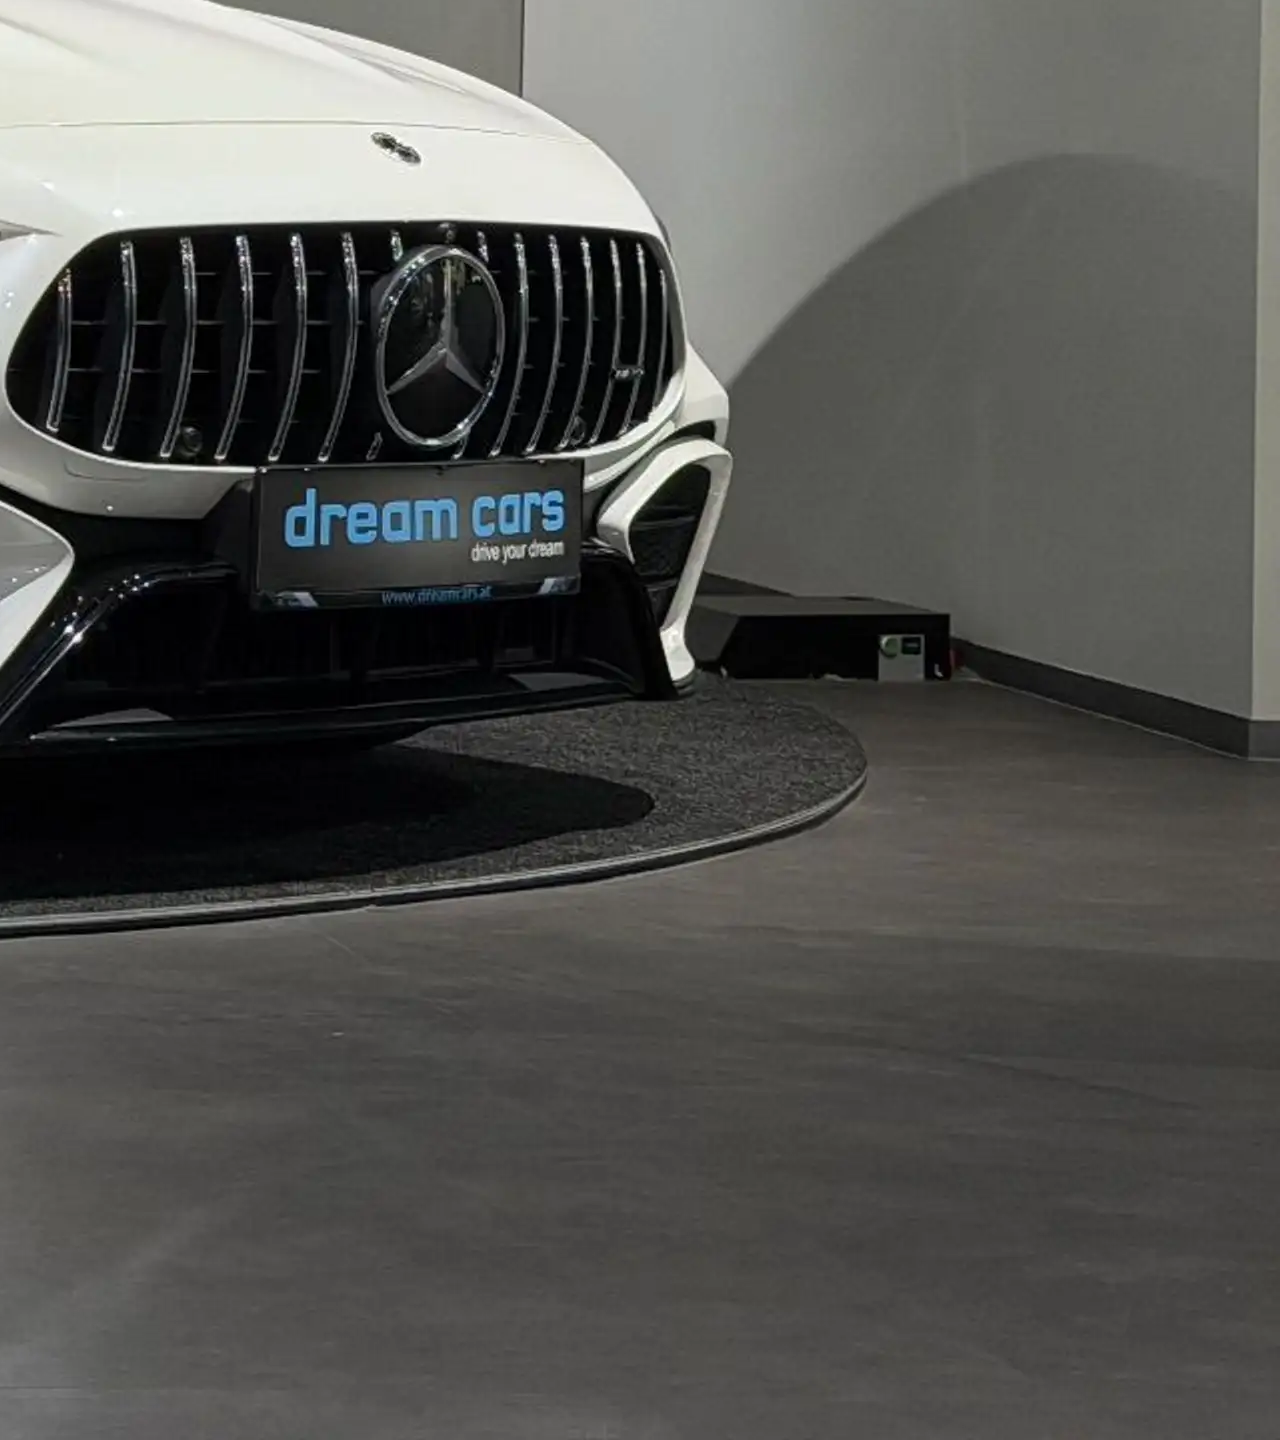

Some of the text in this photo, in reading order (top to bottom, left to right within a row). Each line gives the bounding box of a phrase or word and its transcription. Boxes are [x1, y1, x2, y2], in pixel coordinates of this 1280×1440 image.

[284, 487, 565, 548] dream cars
[470, 539, 565, 565] drive your dream
